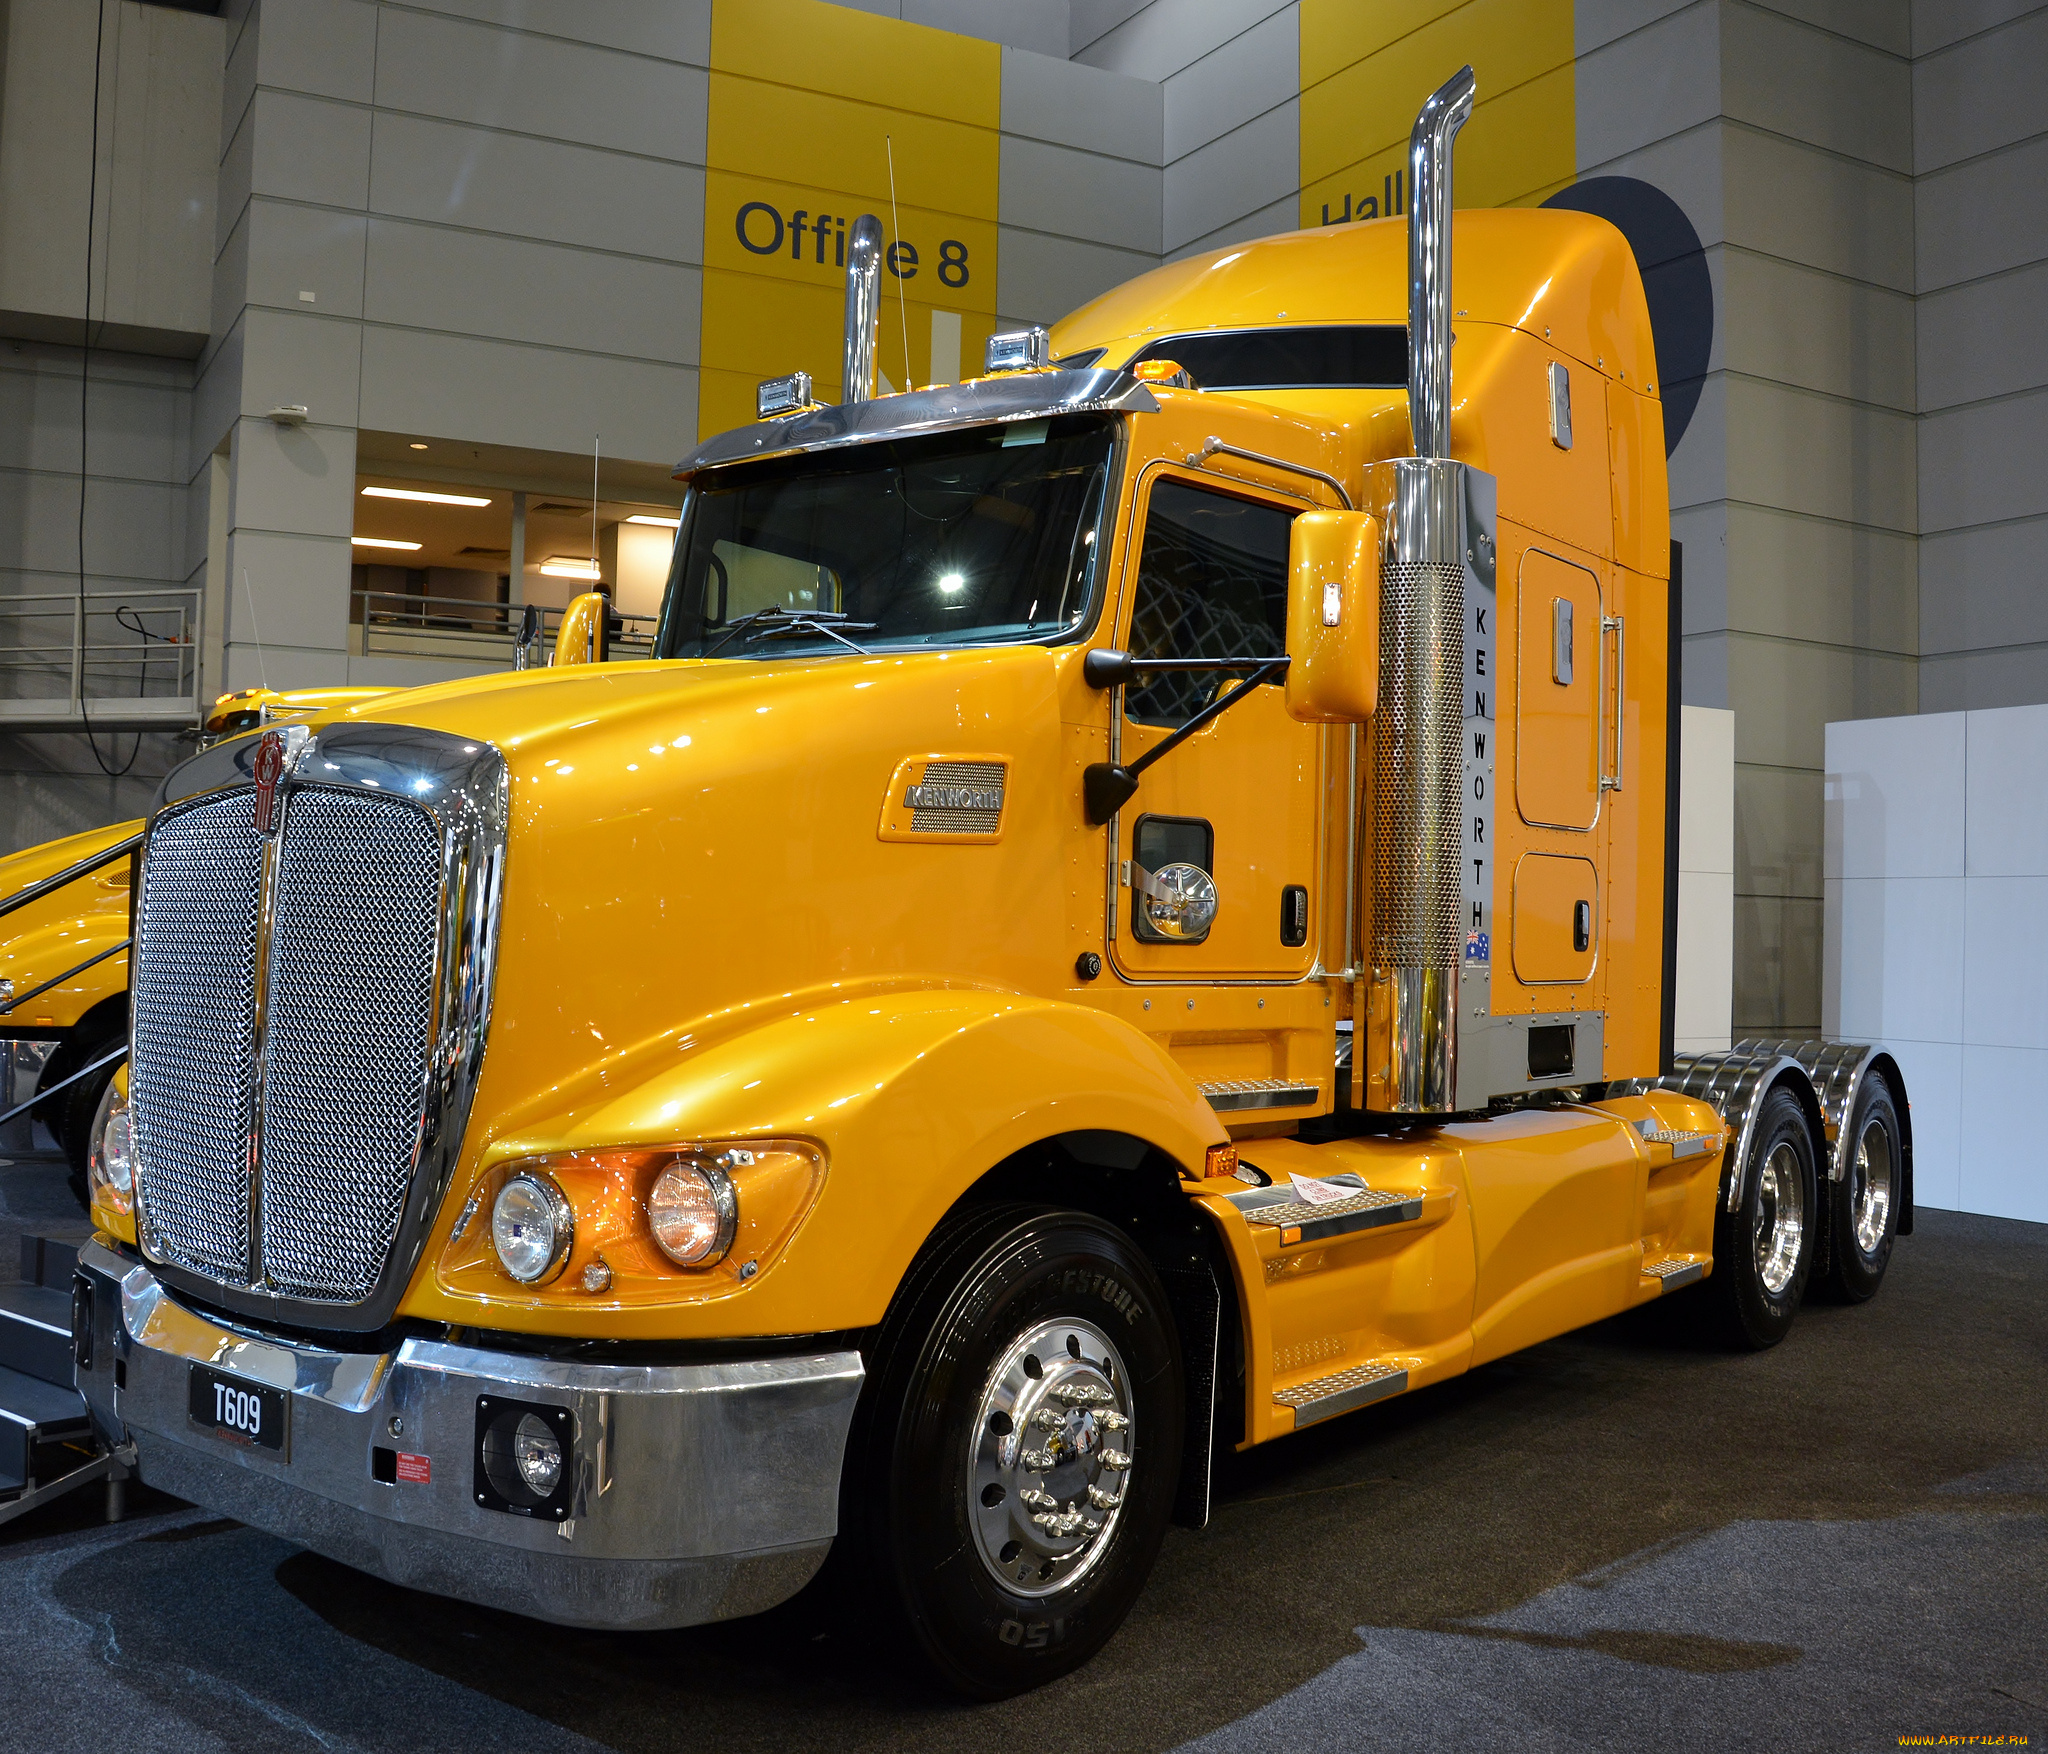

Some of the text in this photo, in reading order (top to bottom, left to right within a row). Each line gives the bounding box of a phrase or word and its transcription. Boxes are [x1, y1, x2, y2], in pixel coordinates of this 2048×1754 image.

[1322, 169, 1403, 226] Hall
[735, 201, 970, 288] Offie 8
[1473, 607, 1487, 928] KENWORTH
[912, 787, 1001, 808] KENWORTH
[213, 1382, 261, 1434] T609
